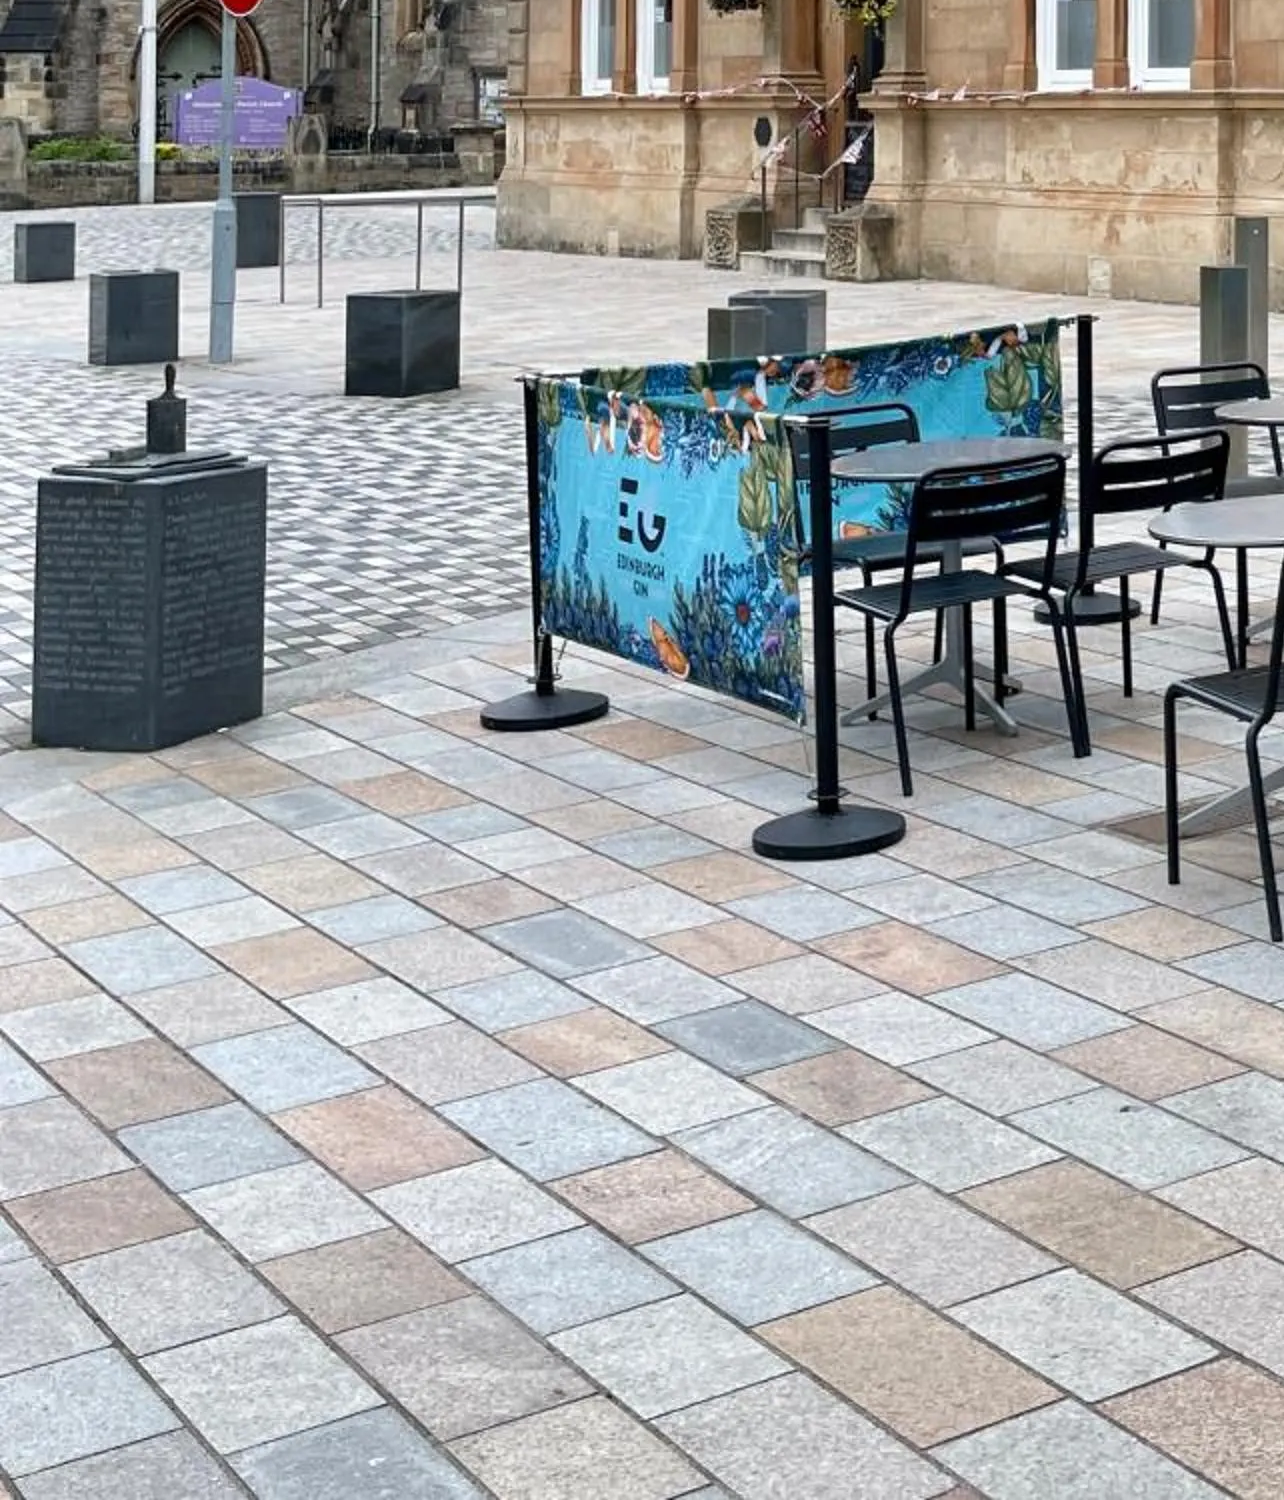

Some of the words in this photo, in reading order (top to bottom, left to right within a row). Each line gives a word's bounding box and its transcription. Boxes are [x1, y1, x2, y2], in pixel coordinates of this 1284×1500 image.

[618, 477, 666, 553] EG
[617, 552, 665, 581] EDINBURGH
[633, 579, 649, 597] GIN
